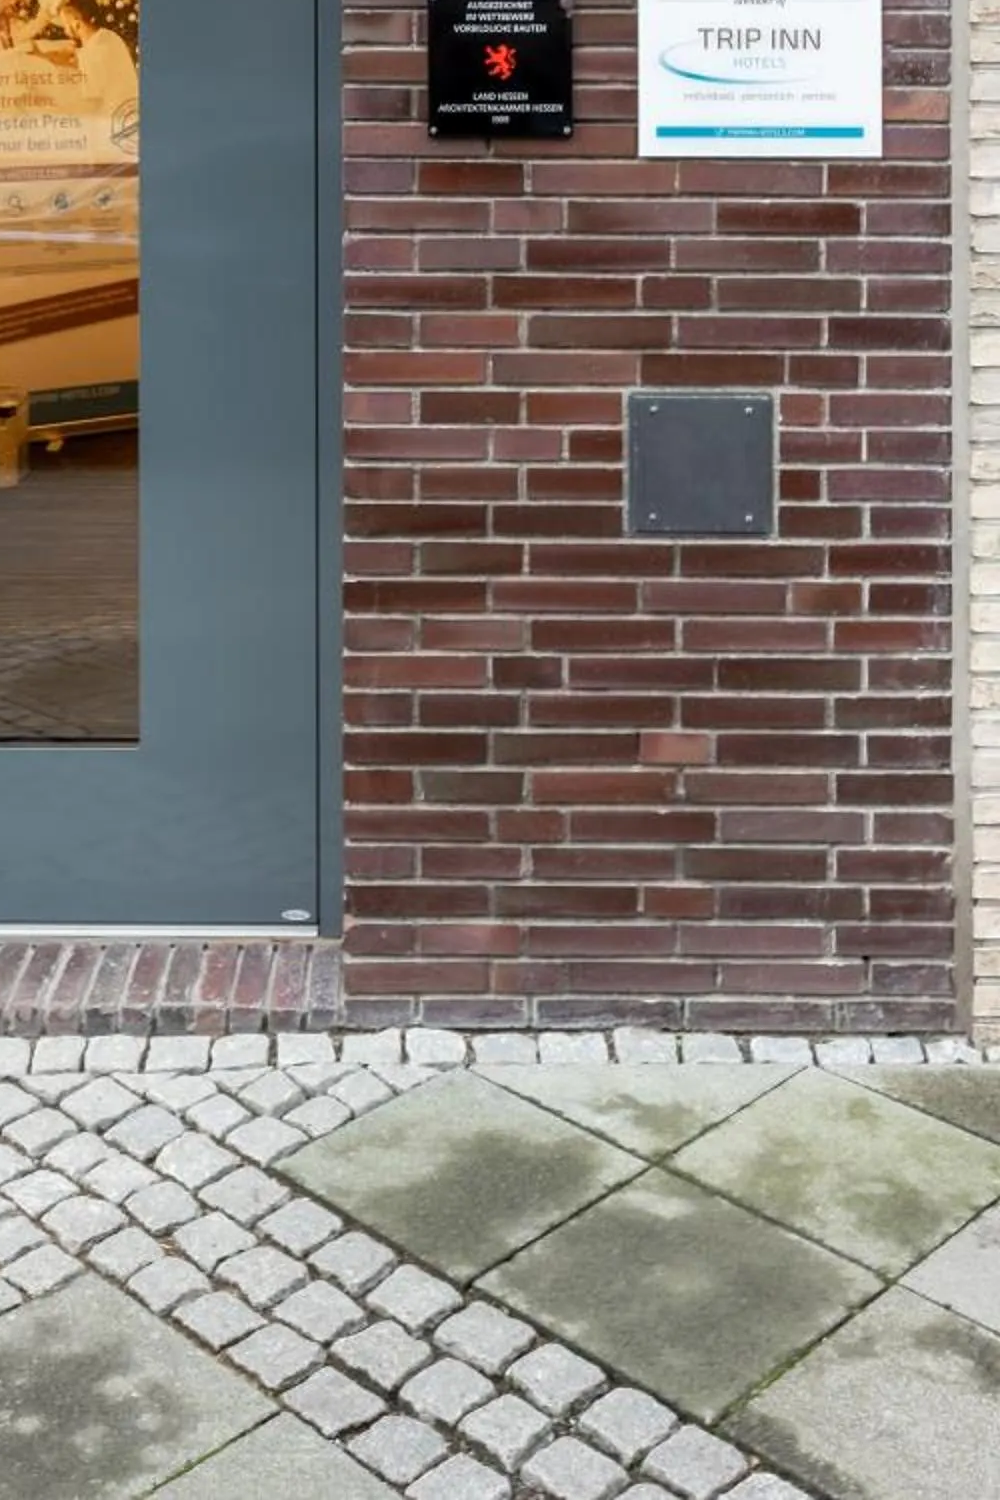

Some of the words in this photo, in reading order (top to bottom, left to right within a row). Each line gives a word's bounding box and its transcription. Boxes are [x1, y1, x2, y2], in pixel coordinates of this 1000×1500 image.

[467, 1, 533, 10] AUSGEZEICHNET
[478, 12, 535, 21] WETTBEWERB
[453, 23, 511, 33] VORBILDLICHE
[513, 23, 548, 33] BAUTEN
[697, 27, 761, 50] TRIP
[771, 27, 822, 50] INN
[733, 56, 786, 69] HOTELS
[15, 70, 53, 86] lässt
[58, 70, 88, 85] sich
[473, 92, 496, 101] LAND
[498, 92, 529, 101] HESSEN
[437, 103, 530, 112] ARCHITEKTENKAMMER
[531, 103, 564, 112] HESSEN
[43, 114, 82, 129] Preis
[27, 137, 52, 151] bei
[54, 135, 88, 151] uns!
